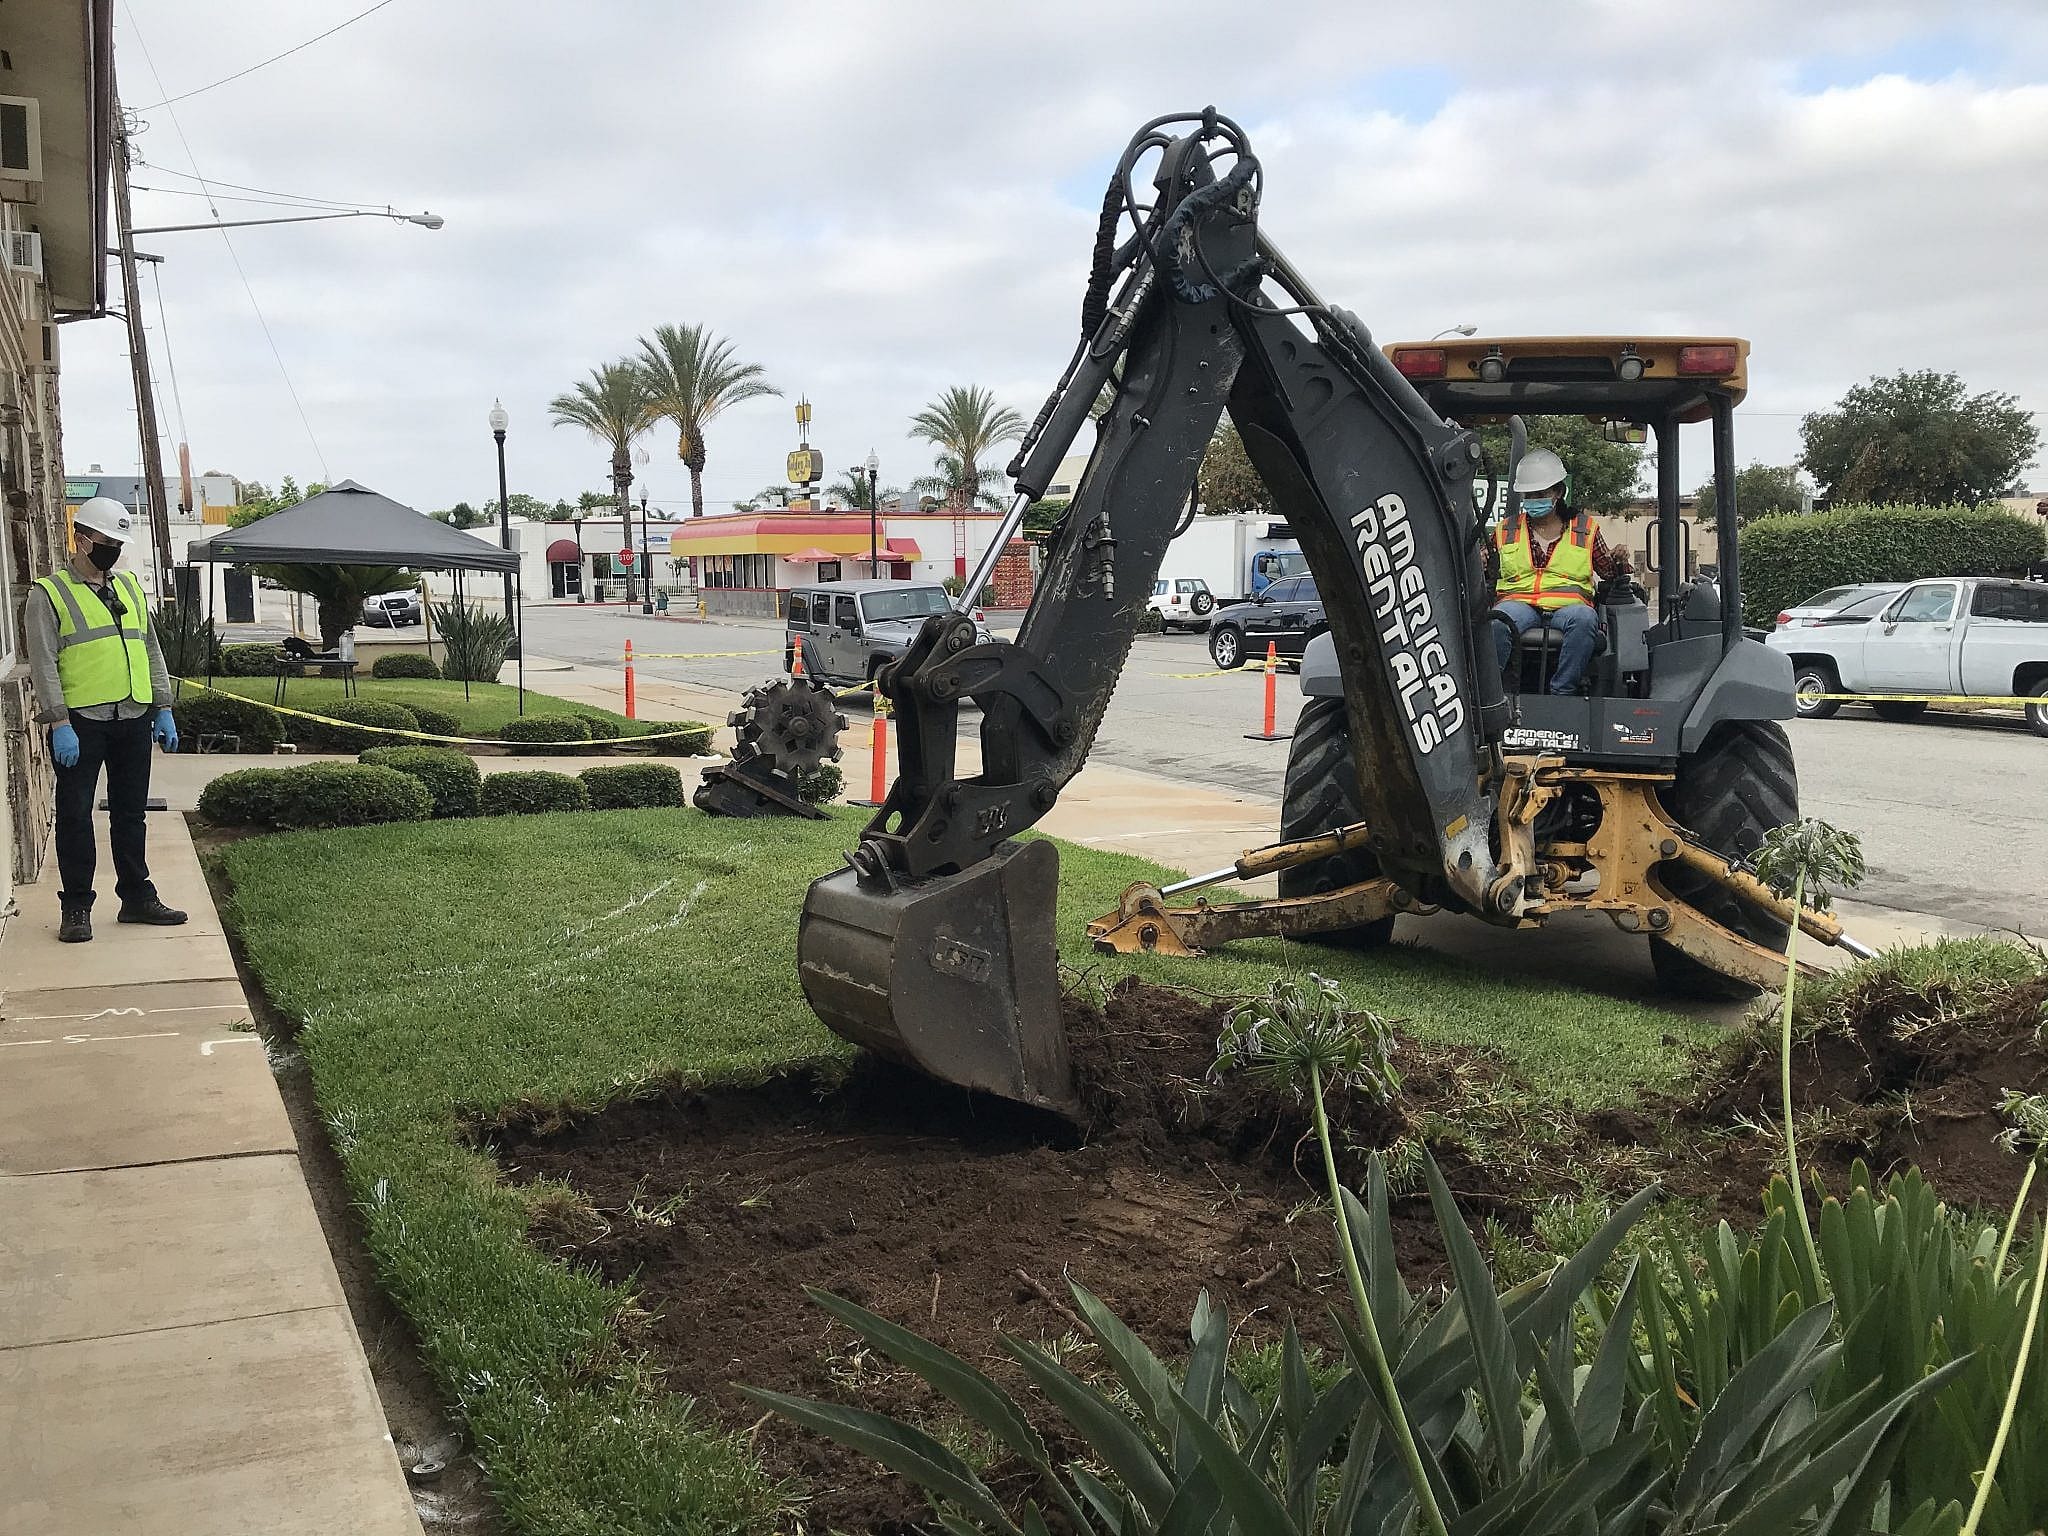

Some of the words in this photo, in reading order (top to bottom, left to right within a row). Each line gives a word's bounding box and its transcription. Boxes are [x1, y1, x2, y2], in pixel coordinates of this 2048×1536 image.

[619, 553, 635, 561] STOP
[1376, 493, 1465, 738] AMERICAN
[1350, 507, 1443, 754] RENTALS
[1517, 737, 1572, 749] RENTALS
